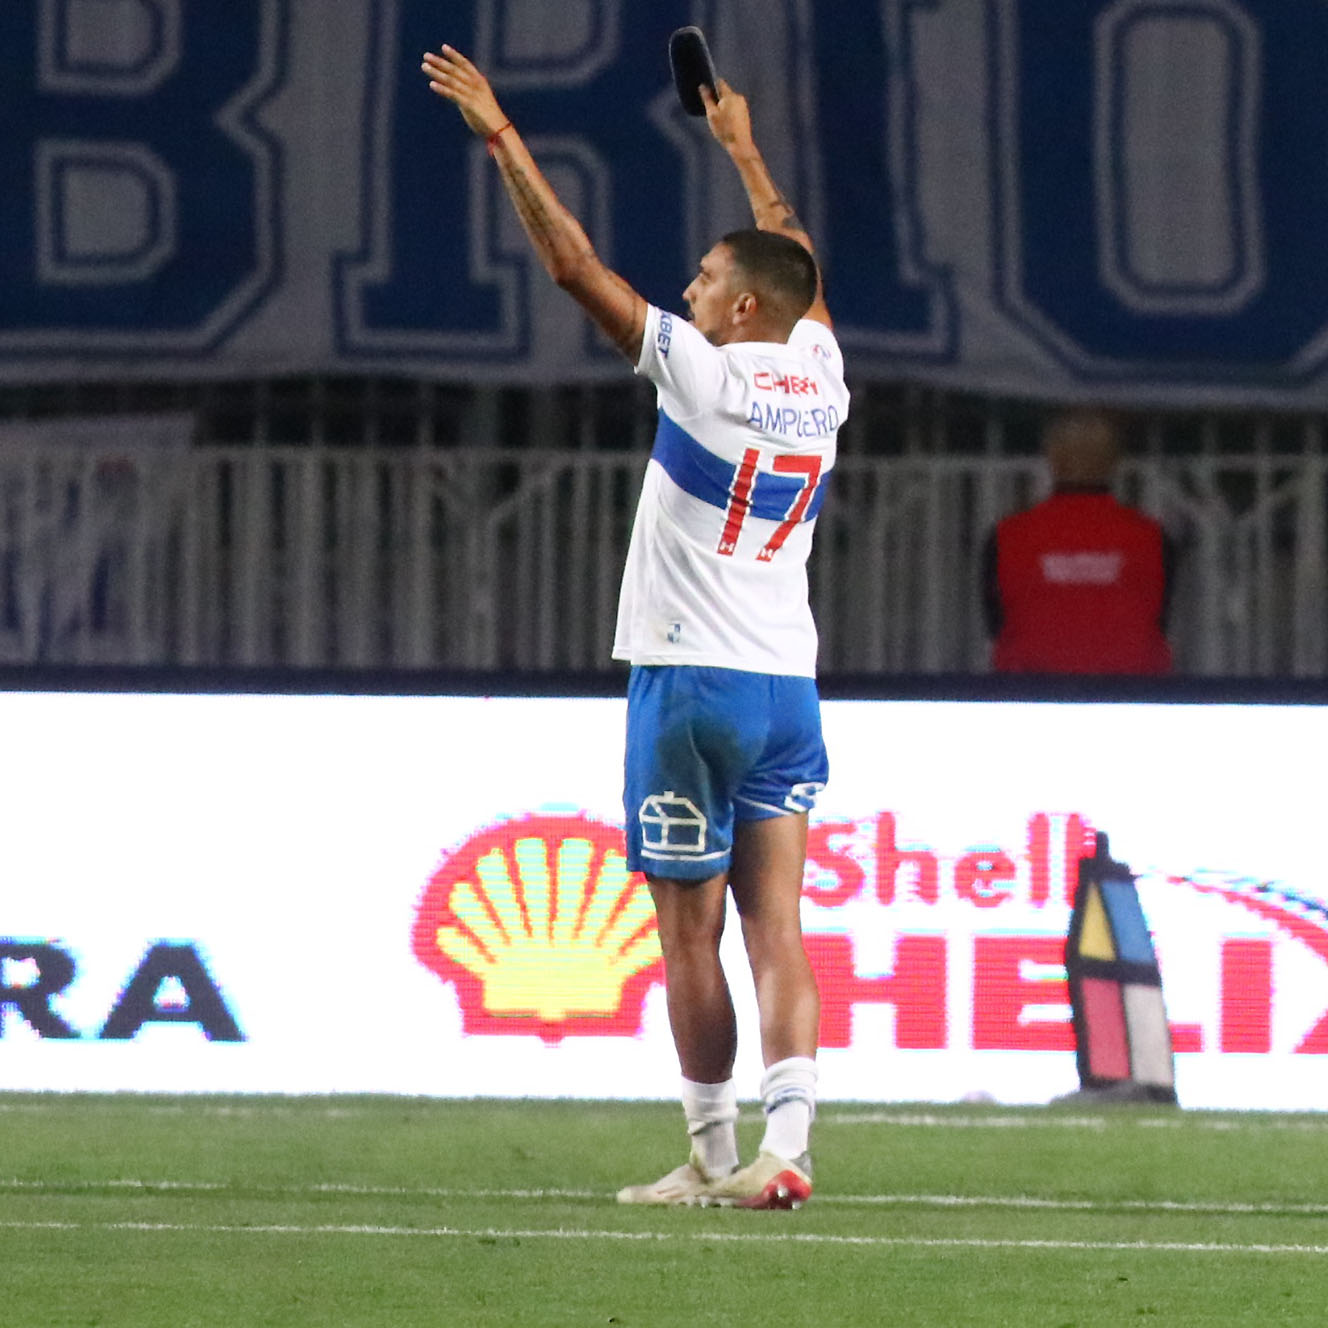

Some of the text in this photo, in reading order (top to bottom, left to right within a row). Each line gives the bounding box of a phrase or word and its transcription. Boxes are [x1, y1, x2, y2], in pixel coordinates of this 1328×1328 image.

[753, 372, 819, 396] CHERY
[717, 447, 823, 562] 17
[800, 810, 1092, 909] Shell
